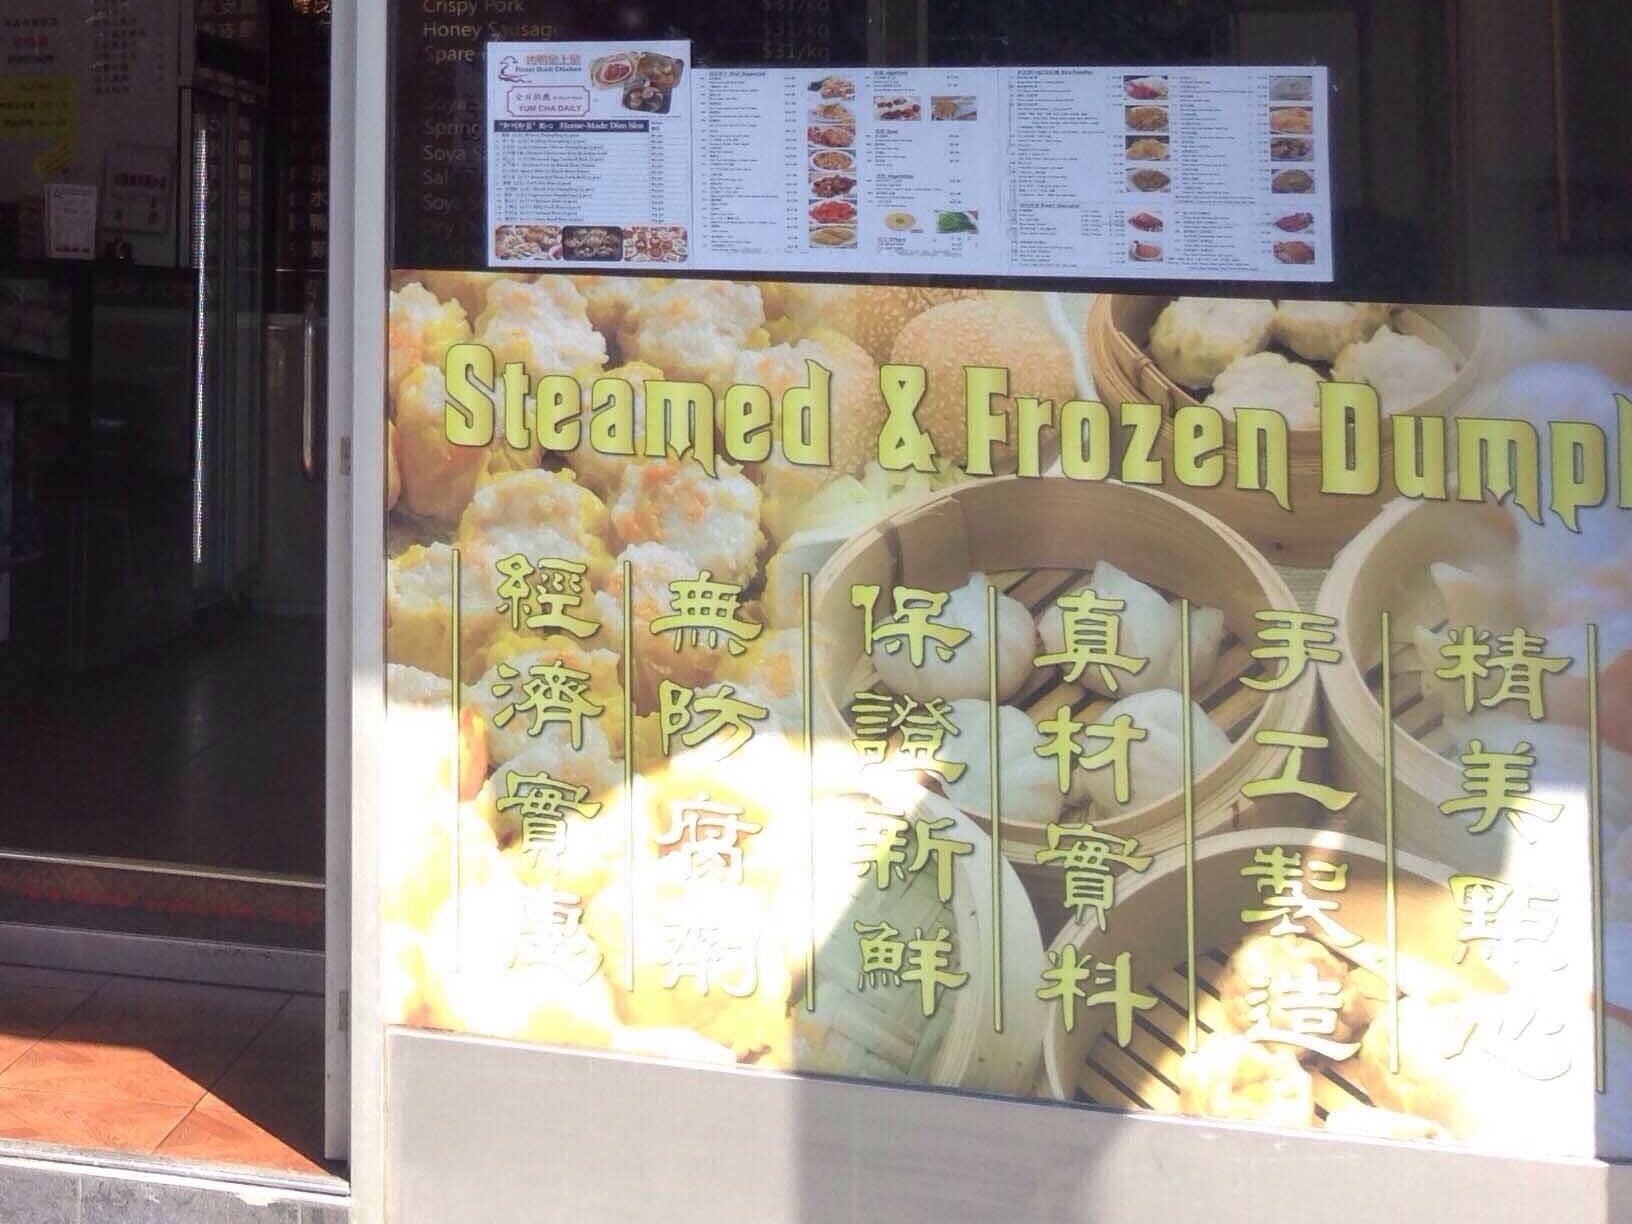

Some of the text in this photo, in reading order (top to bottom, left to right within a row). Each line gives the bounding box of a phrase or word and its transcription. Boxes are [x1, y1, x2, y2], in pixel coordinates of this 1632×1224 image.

[422, 22, 480, 41] Honey
[423, 46, 475, 64] Spare
[538, 105, 557, 113] CHA
[558, 104, 582, 113] DAILY
[443, 342, 833, 480] Steamed
[877, 363, 939, 475] &
[965, 364, 1294, 513] Frozen
[1032, 593, 1160, 1051] 真材實料
[1239, 608, 1366, 1063] 手工製造
